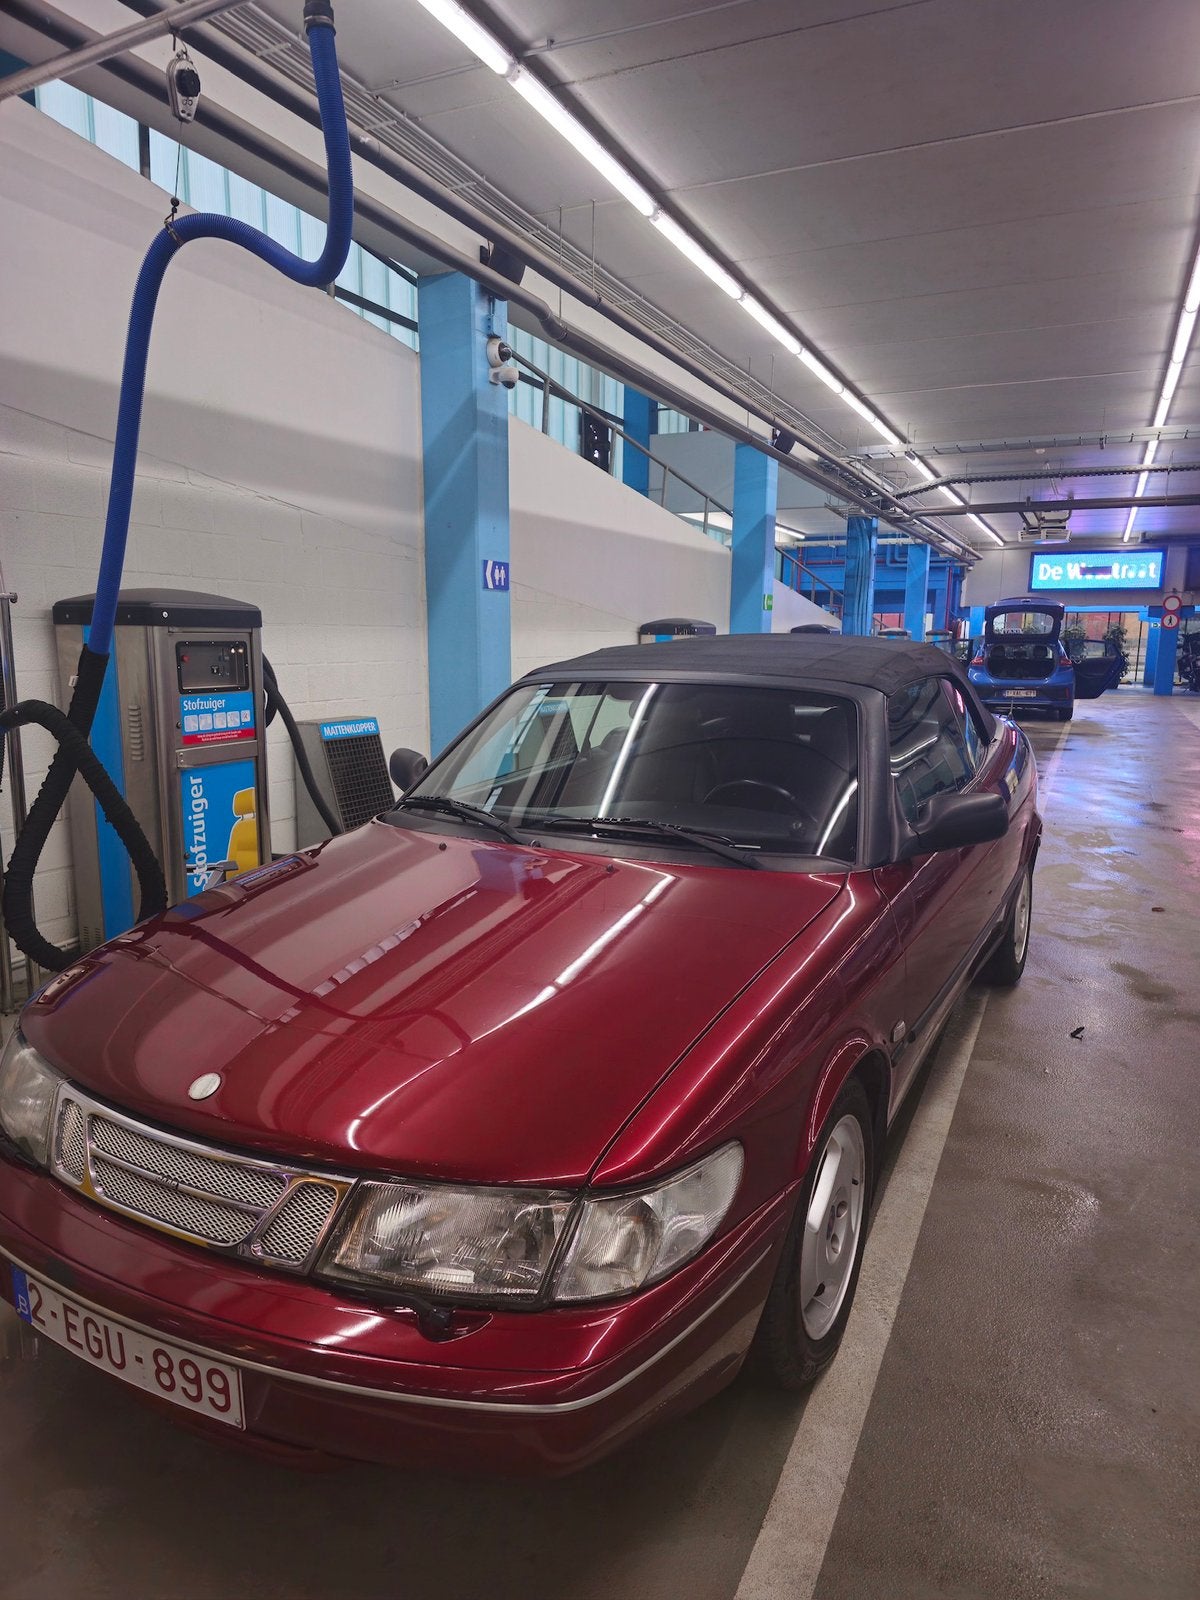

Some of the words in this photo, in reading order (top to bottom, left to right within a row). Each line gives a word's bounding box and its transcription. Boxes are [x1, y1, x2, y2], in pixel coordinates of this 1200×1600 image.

[1039, 563, 1063, 580] De
[183, 697, 226, 711] Stofzuiger
[323, 721, 377, 737] MATTENKLOPPER
[188, 776, 209, 887] Stofzuiger
[18, 1294, 29, 1315] B
[28, 1282, 232, 1413] 2-EGU-899
